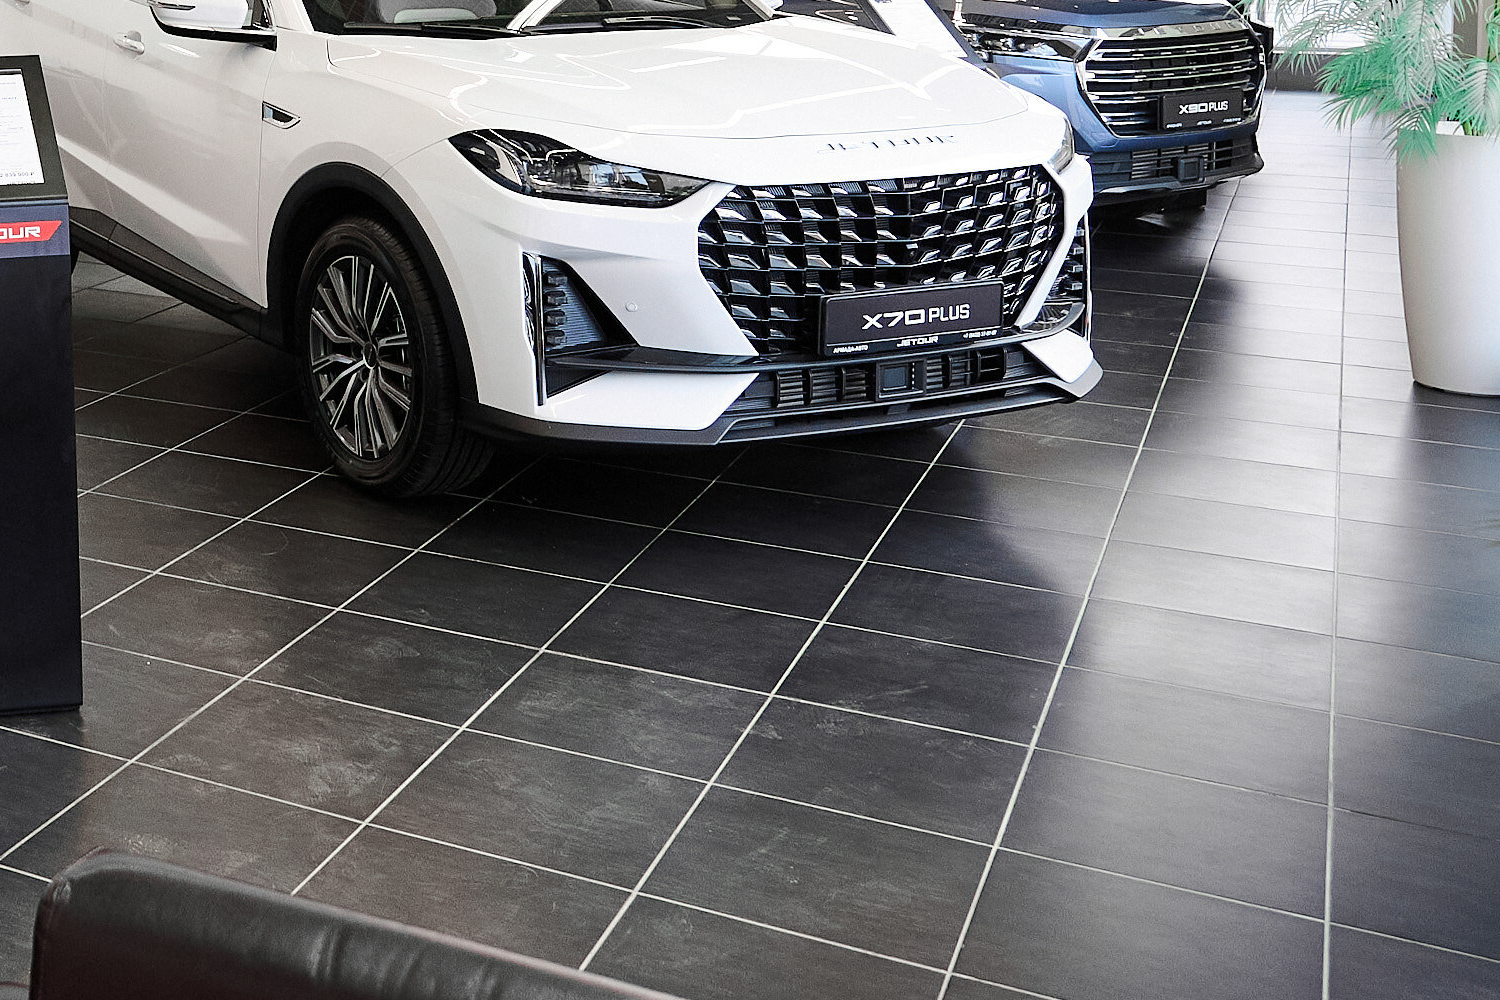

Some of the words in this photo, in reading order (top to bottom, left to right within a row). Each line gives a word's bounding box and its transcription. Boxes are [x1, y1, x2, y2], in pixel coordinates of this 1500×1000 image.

[1208, 100, 1229, 112] PLUS
[861, 309, 926, 331] X70
[928, 303, 971, 323] PLUS
[896, 335, 939, 348] JETOUR
